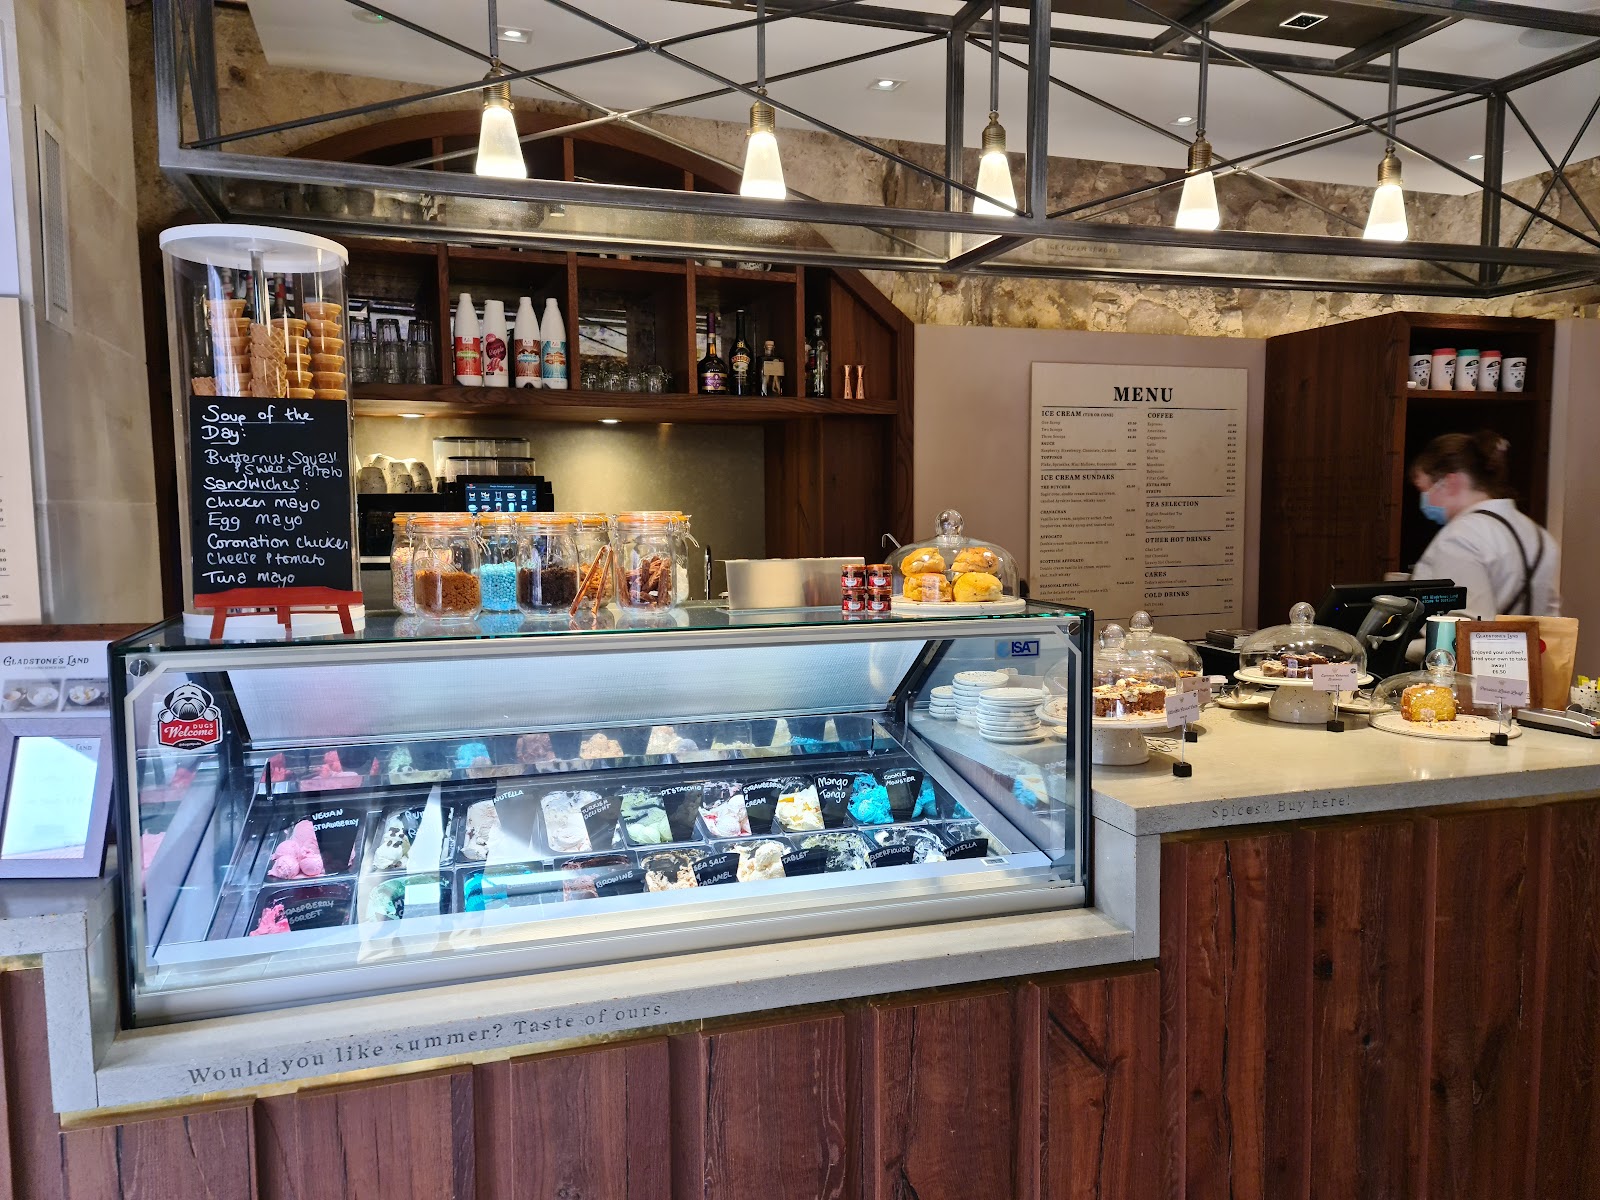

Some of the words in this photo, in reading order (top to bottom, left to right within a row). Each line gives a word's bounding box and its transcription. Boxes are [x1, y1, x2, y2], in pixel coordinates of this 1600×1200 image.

[1114, 386, 1173, 402] MENU
[202, 405, 246, 424] Soup
[258, 405, 276, 424] of
[284, 408, 314, 421] the
[202, 425, 246, 445] Day:
[204, 449, 285, 465] Butternut
[275, 499, 320, 512] mayo
[208, 512, 240, 531] Egg
[256, 514, 303, 531] mayo
[208, 533, 290, 549] Coronation
[207, 553, 257, 565] Cheese
[202, 570, 247, 584] Tuna
[258, 573, 295, 587] mayo
[1011, 641, 1032, 654] ISA
[4, 656, 64, 666] GLADSTONE'S
[67, 655, 89, 666] LAND
[164, 725, 213, 738] Welcome
[818, 776, 848, 789] Mango
[745, 798, 766, 808] CREAM
[819, 789, 846, 804] Tango
[311, 808, 344, 820] VEGAN
[1212, 802, 1270, 821] Spices?
[1278, 800, 1306, 813] Buy
[1312, 795, 1351, 808] here!
[313, 818, 359, 831] STRAWBERRY
[693, 862, 707, 871] SEA
[709, 856, 727, 867] SALT
[782, 850, 811, 865] TABLET
[188, 1057, 269, 1086] Would
[282, 1052, 325, 1075] you
[336, 1043, 384, 1064] like
[394, 1023, 504, 1055] summer?
[513, 1015, 576, 1037] Taste
[584, 1008, 608, 1026] of
[615, 1003, 669, 1023] ours.
